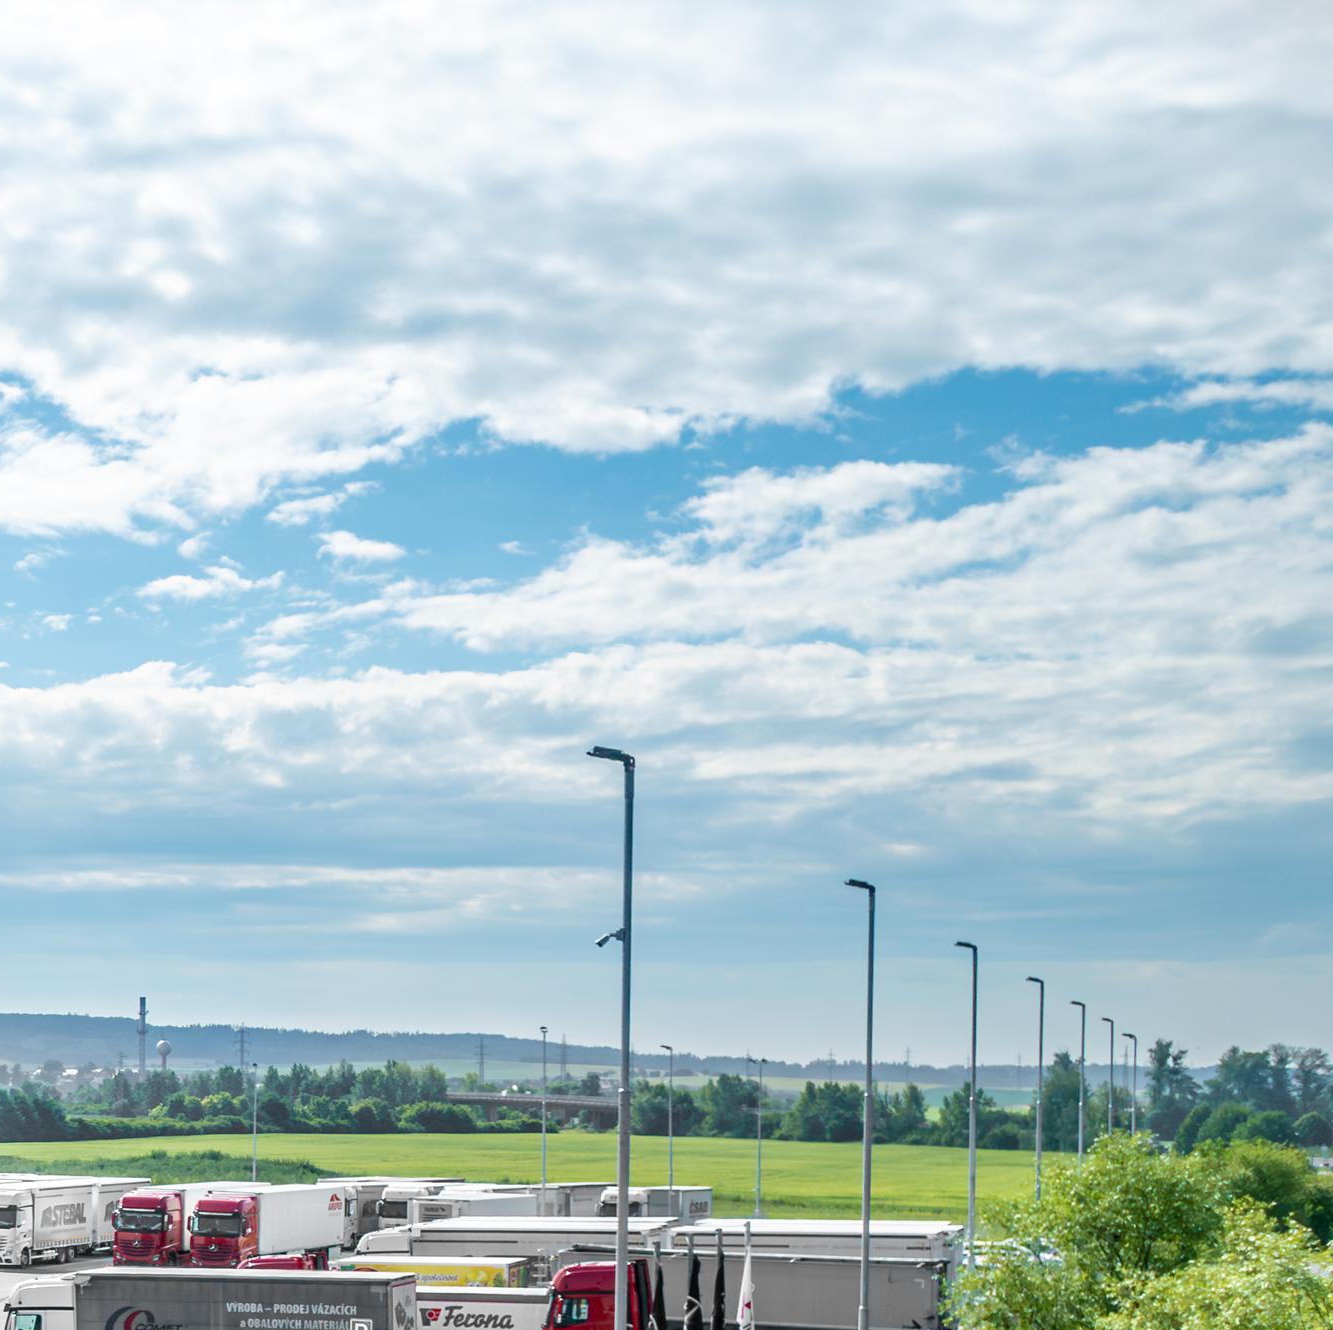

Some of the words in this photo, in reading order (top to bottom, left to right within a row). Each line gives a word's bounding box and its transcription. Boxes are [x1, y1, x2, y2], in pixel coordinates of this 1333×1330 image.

[226, 1301, 263, 1313] VÝROBA
[273, 1304, 309, 1315] PRODEJ
[311, 1303, 357, 1316] VÁZACÍCH
[247, 1317, 301, 1329] OBALOVÝCH
[303, 1319, 349, 1330] MATERIÁL
[443, 1305, 514, 1329] Ferona
